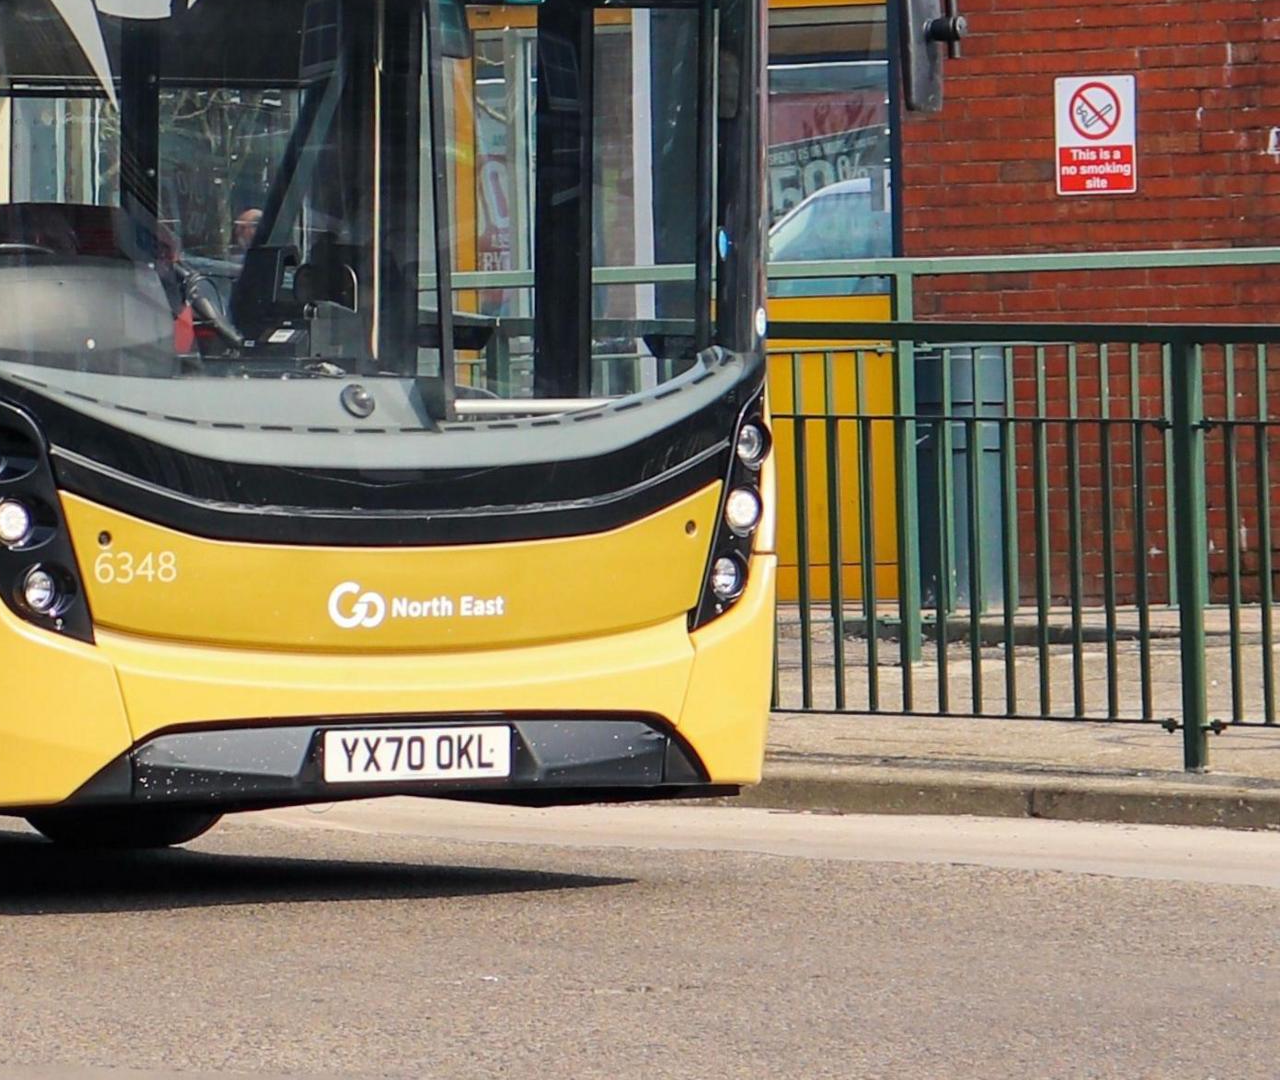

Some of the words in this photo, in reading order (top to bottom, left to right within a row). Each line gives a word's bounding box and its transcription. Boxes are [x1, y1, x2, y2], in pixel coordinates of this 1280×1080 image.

[1070, 149, 1096, 161] This
[1099, 149, 1110, 161] is
[1112, 151, 1121, 161] a
[1061, 165, 1077, 176] no
[1080, 163, 1132, 177] smoking
[1085, 177, 1108, 189] site
[94, 550, 178, 583] 6348
[392, 595, 453, 618] North
[460, 595, 504, 617] East
[342, 734, 424, 775] YX70
[435, 731, 494, 771] OKL
